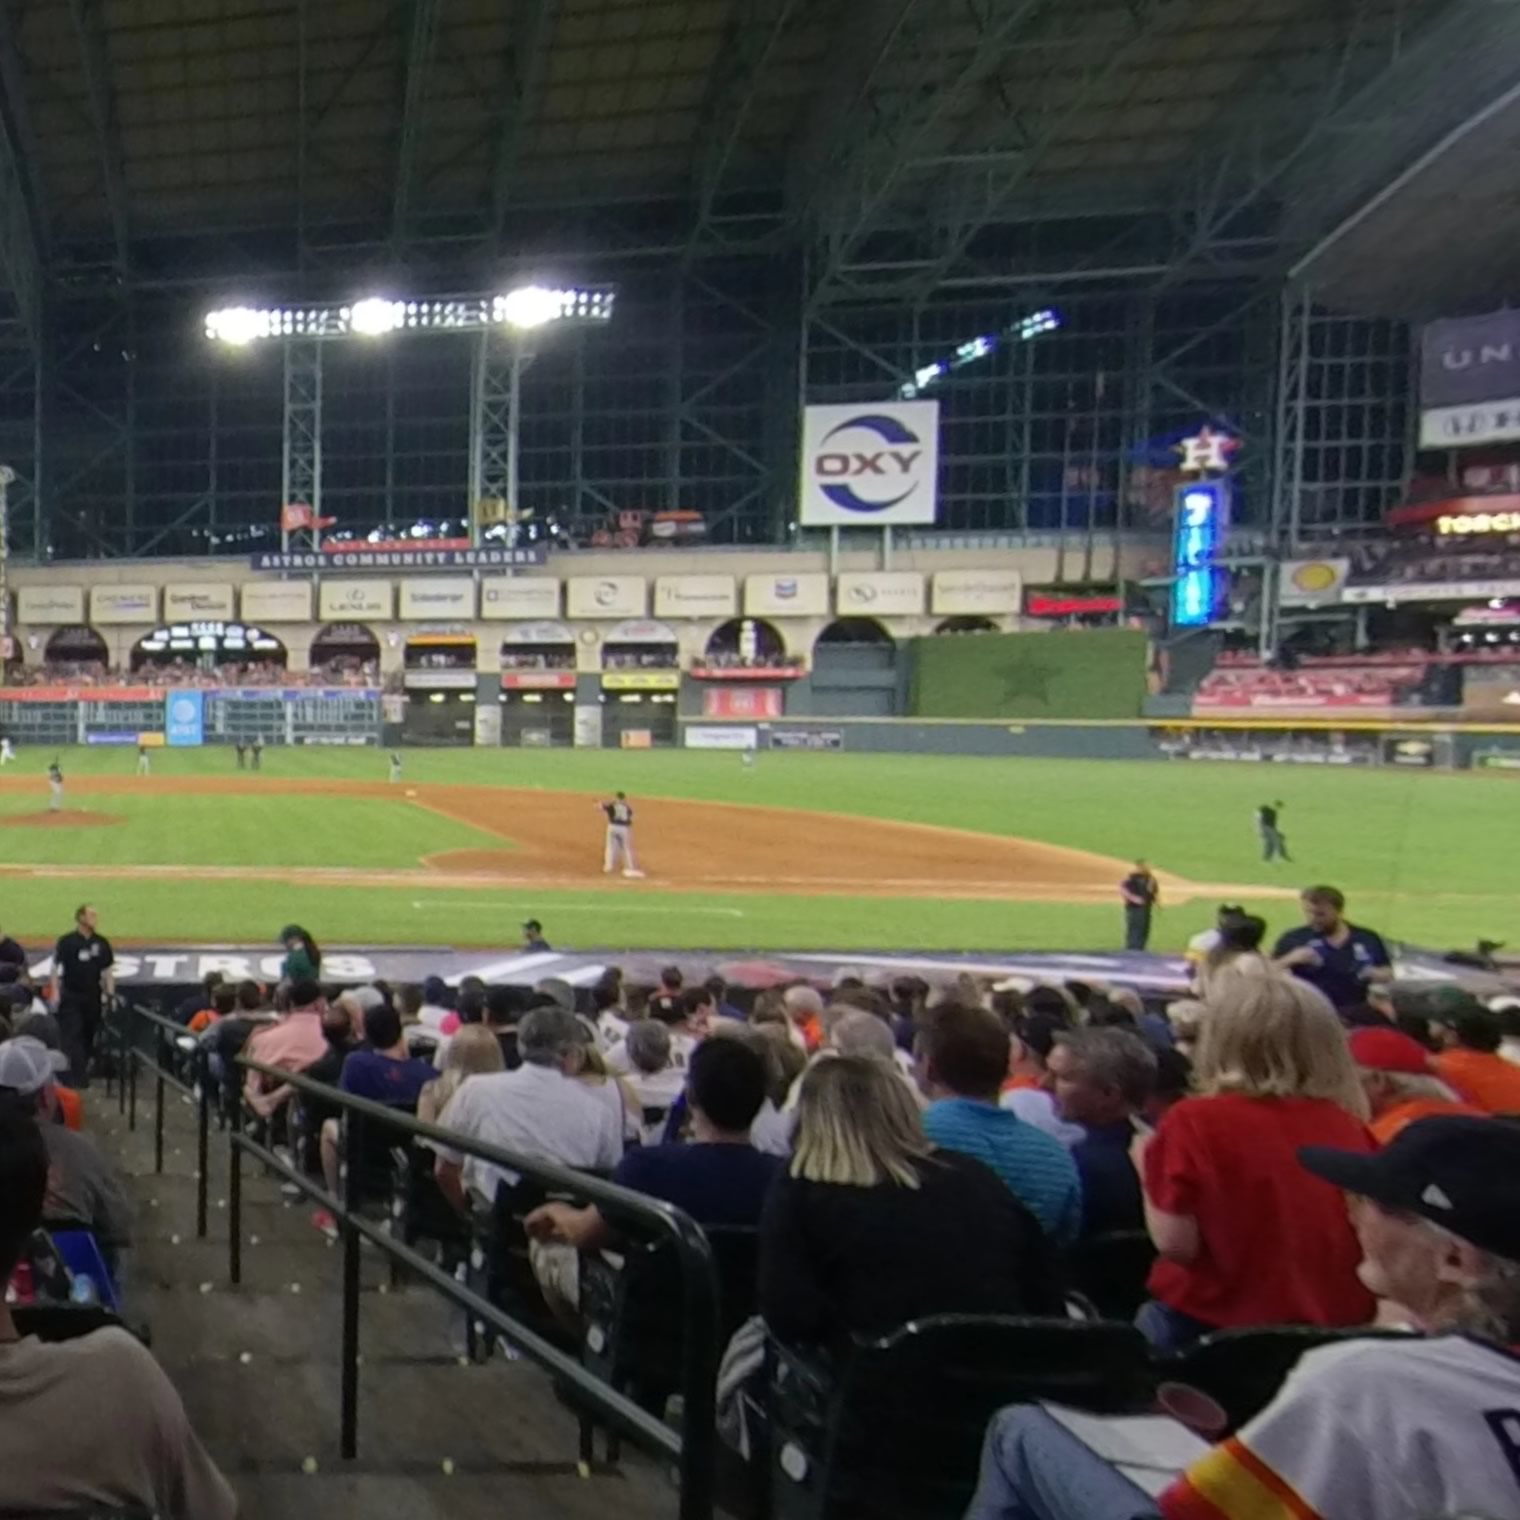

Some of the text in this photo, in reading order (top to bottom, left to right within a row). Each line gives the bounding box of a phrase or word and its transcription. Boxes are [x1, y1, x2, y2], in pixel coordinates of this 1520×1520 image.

[1443, 343, 1520, 370] UN
[815, 450, 923, 476] OXY
[260, 550, 537, 568] ASTROS COMMUNITY LEADERS
